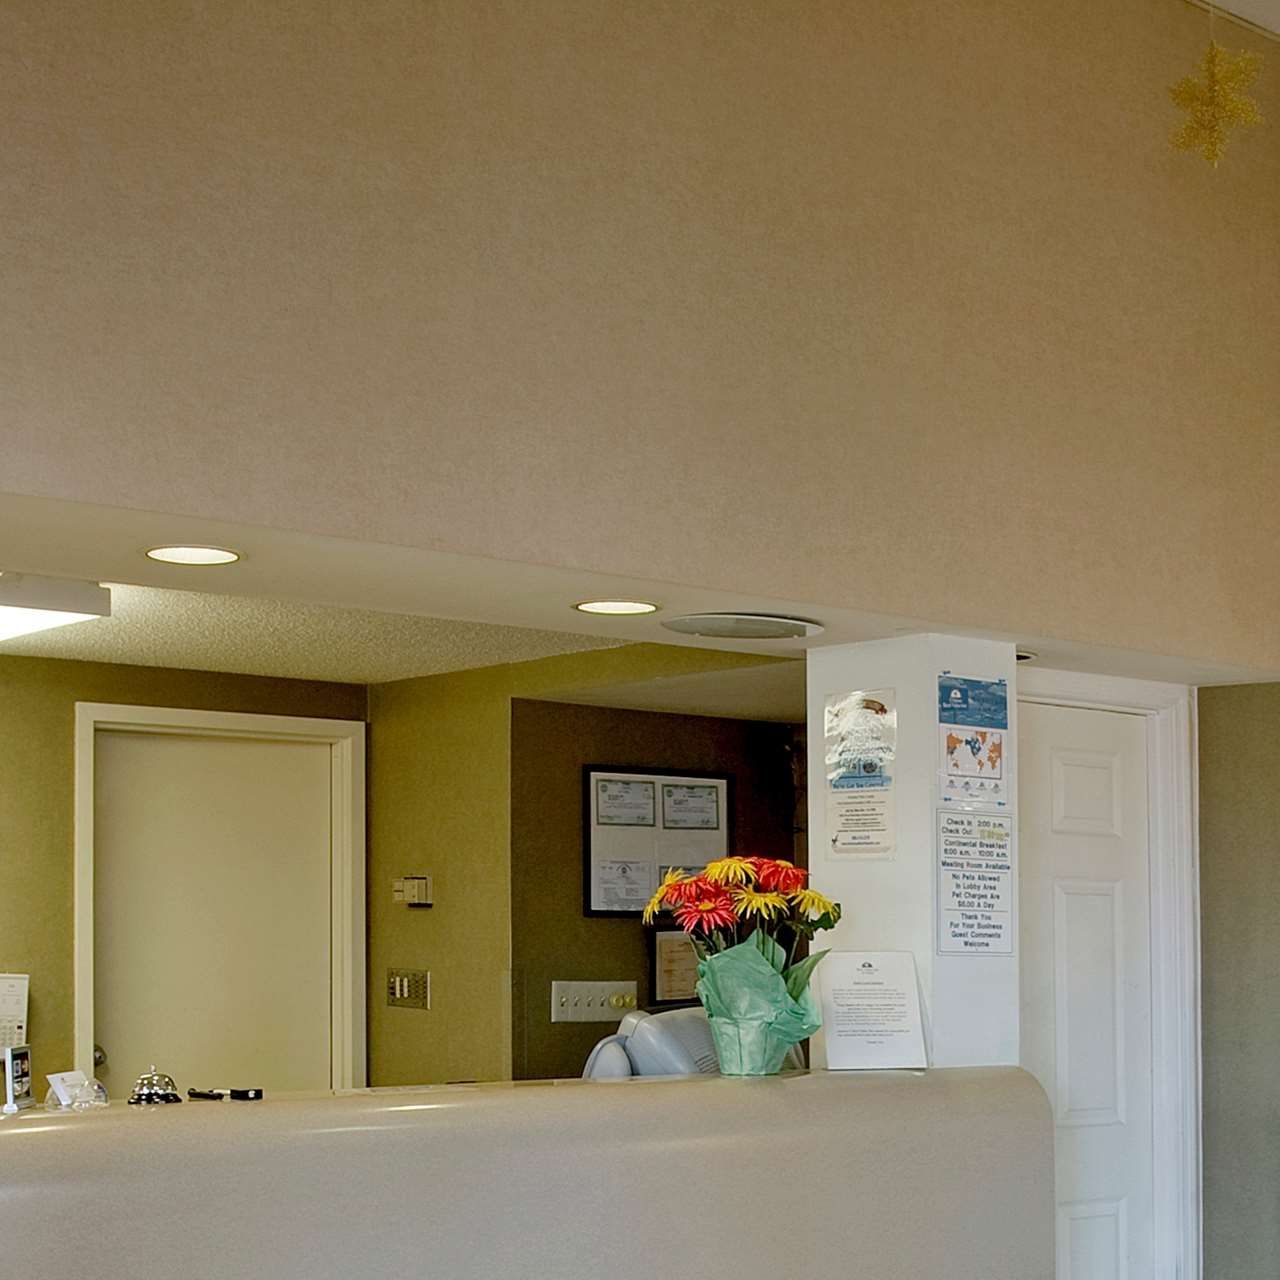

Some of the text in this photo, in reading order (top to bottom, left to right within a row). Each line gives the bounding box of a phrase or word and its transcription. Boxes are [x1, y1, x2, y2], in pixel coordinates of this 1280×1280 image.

[946, 818, 964, 826] Check
[941, 826, 959, 834] Check
[944, 839, 1008, 850] Continental Breakfast
[941, 860, 964, 869] Meeting
[985, 862, 1010, 870] Available
[977, 874, 1000, 882] Allowed
[963, 883, 980, 891] Lobby
[964, 892, 988, 900] Charges
[977, 922, 1002, 930] Business
[951, 930, 969, 938] Guest
